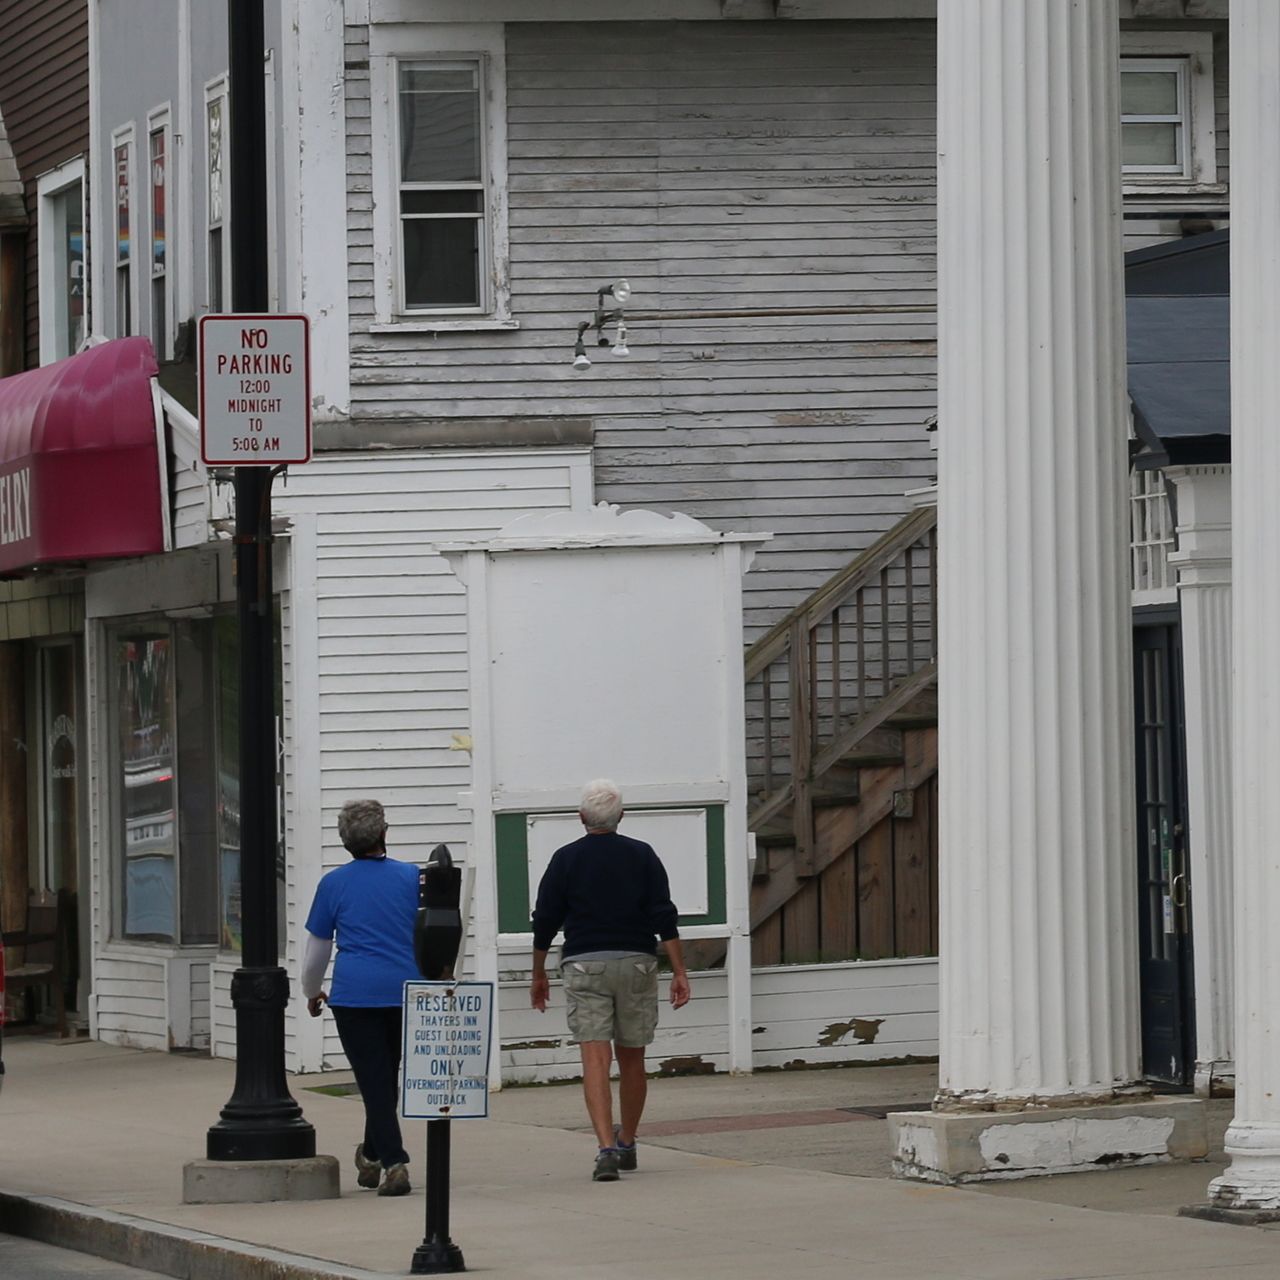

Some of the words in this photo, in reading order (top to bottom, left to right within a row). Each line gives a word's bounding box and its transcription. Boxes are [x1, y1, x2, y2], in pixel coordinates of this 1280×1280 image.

[241, 328, 268, 349] NO
[218, 354, 292, 374] PARKING
[240, 380, 270, 393] 12:00
[228, 399, 282, 413] MIDNIGHT
[249, 418, 263, 432] TO
[232, 437, 259, 451] 5:00
[263, 437, 280, 451] AM
[416, 995, 482, 1012] RESERVED
[420, 1016, 461, 1027] THAYERS
[463, 1016, 477, 1026] INN
[415, 1030, 442, 1041] GUEST
[445, 1030, 482, 1041] LOADING
[414, 1045, 431, 1055] AND
[435, 1045, 482, 1055] UNLOADING
[431, 1059, 464, 1075] ONLY
[406, 1079, 450, 1090] OVERNIGHT
[454, 1079, 486, 1090] PARKING
[427, 1094, 466, 1105] OUTBACK
